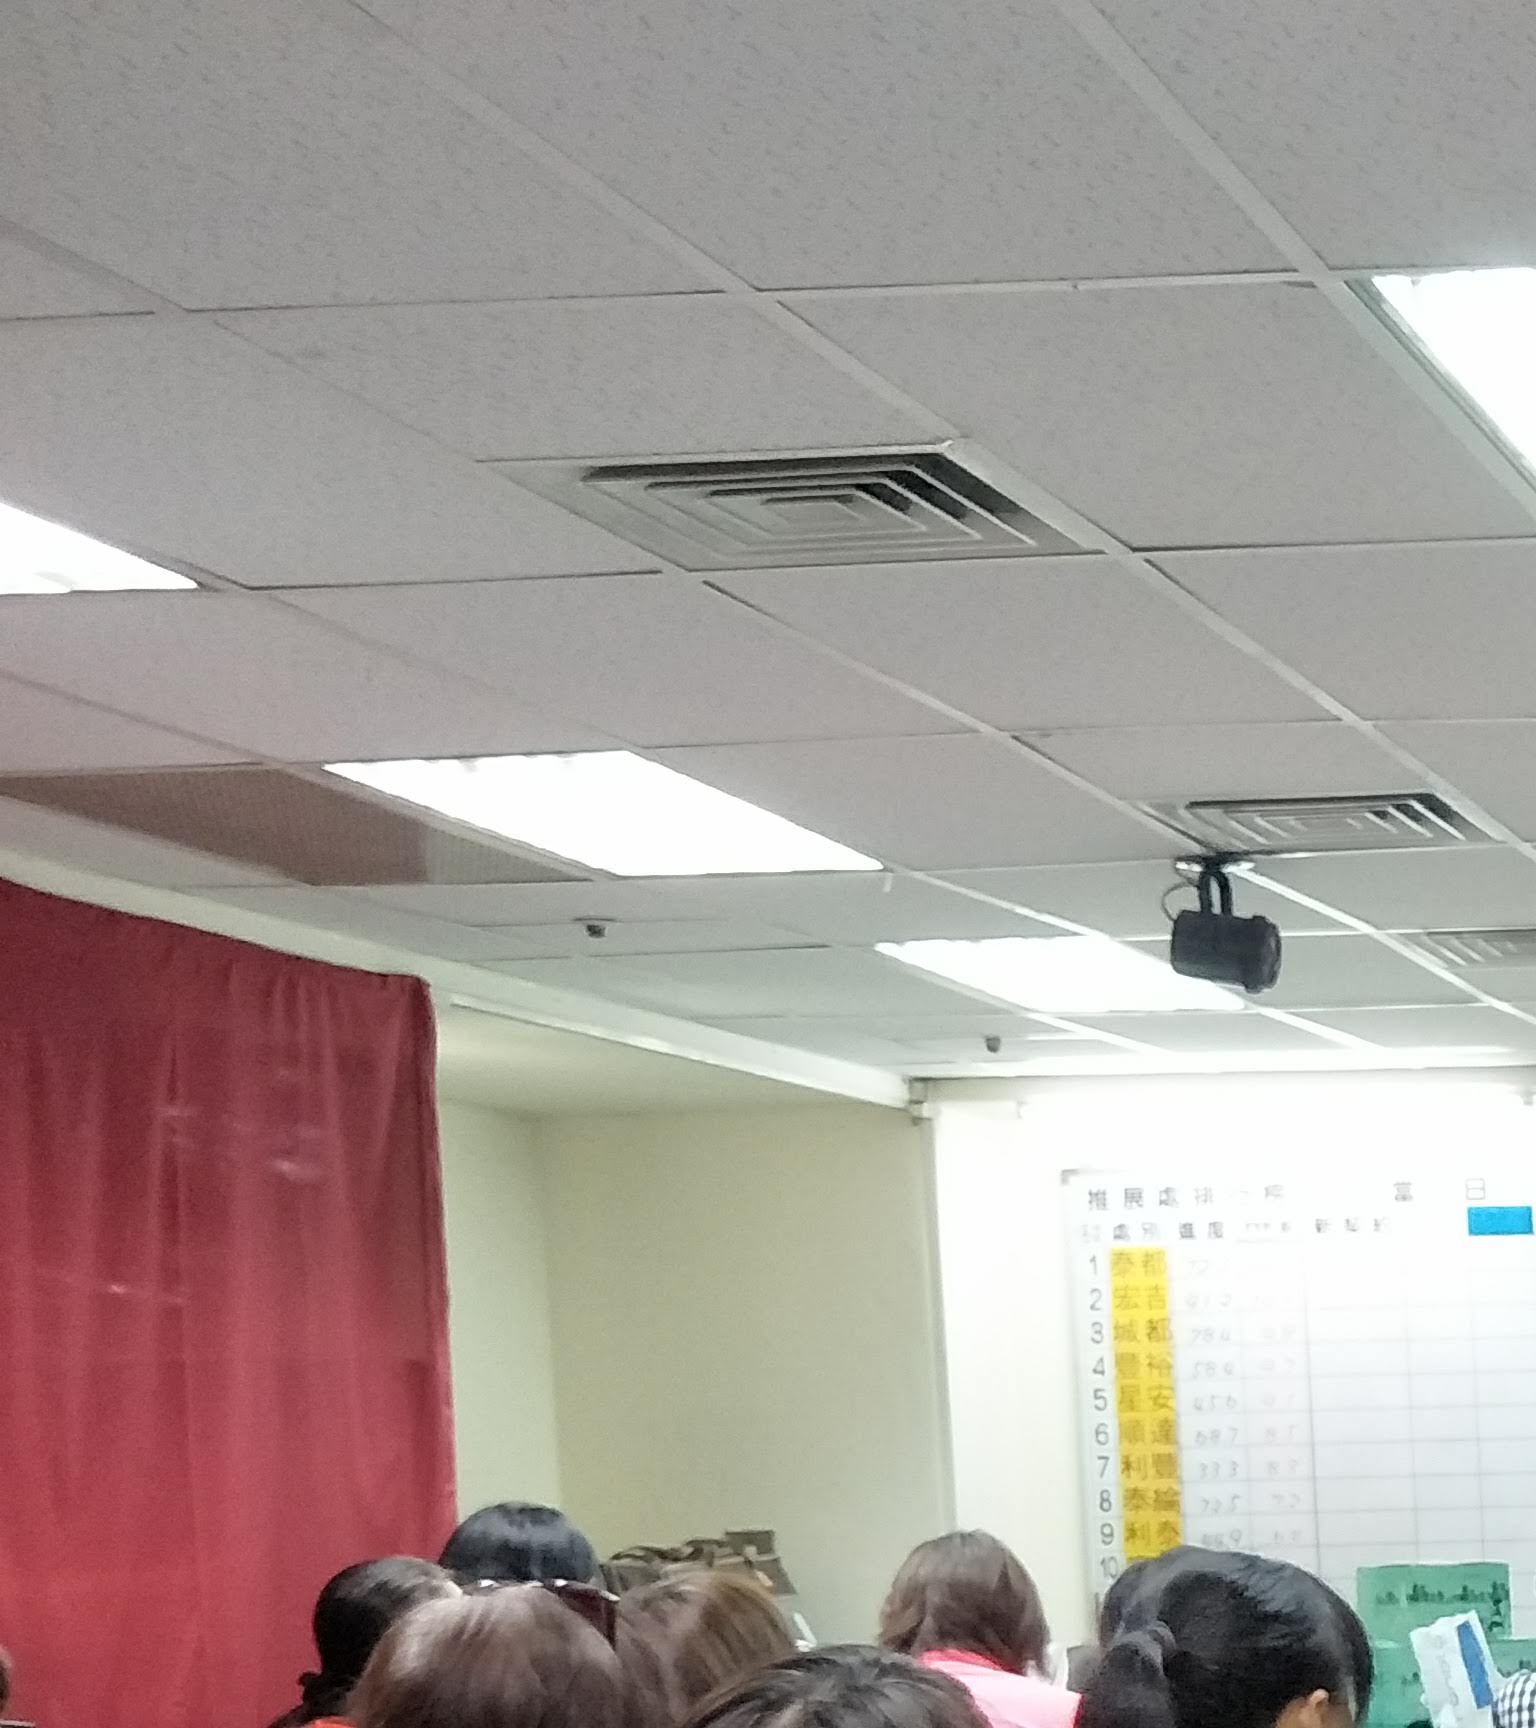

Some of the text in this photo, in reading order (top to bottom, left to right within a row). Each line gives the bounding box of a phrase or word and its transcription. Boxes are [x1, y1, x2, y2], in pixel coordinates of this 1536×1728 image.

[1089, 1254, 1099, 1276] 1
[1089, 1287, 1103, 1312] 2
[1090, 1321, 1105, 1345] 3
[1091, 1356, 1106, 1377] 4
[1092, 1388, 1108, 1412] 5
[1094, 1422, 1110, 1446] 6
[1096, 1455, 1111, 1480] 7
[1098, 1488, 1113, 1513] 8
[1100, 1522, 1115, 1546] 9
